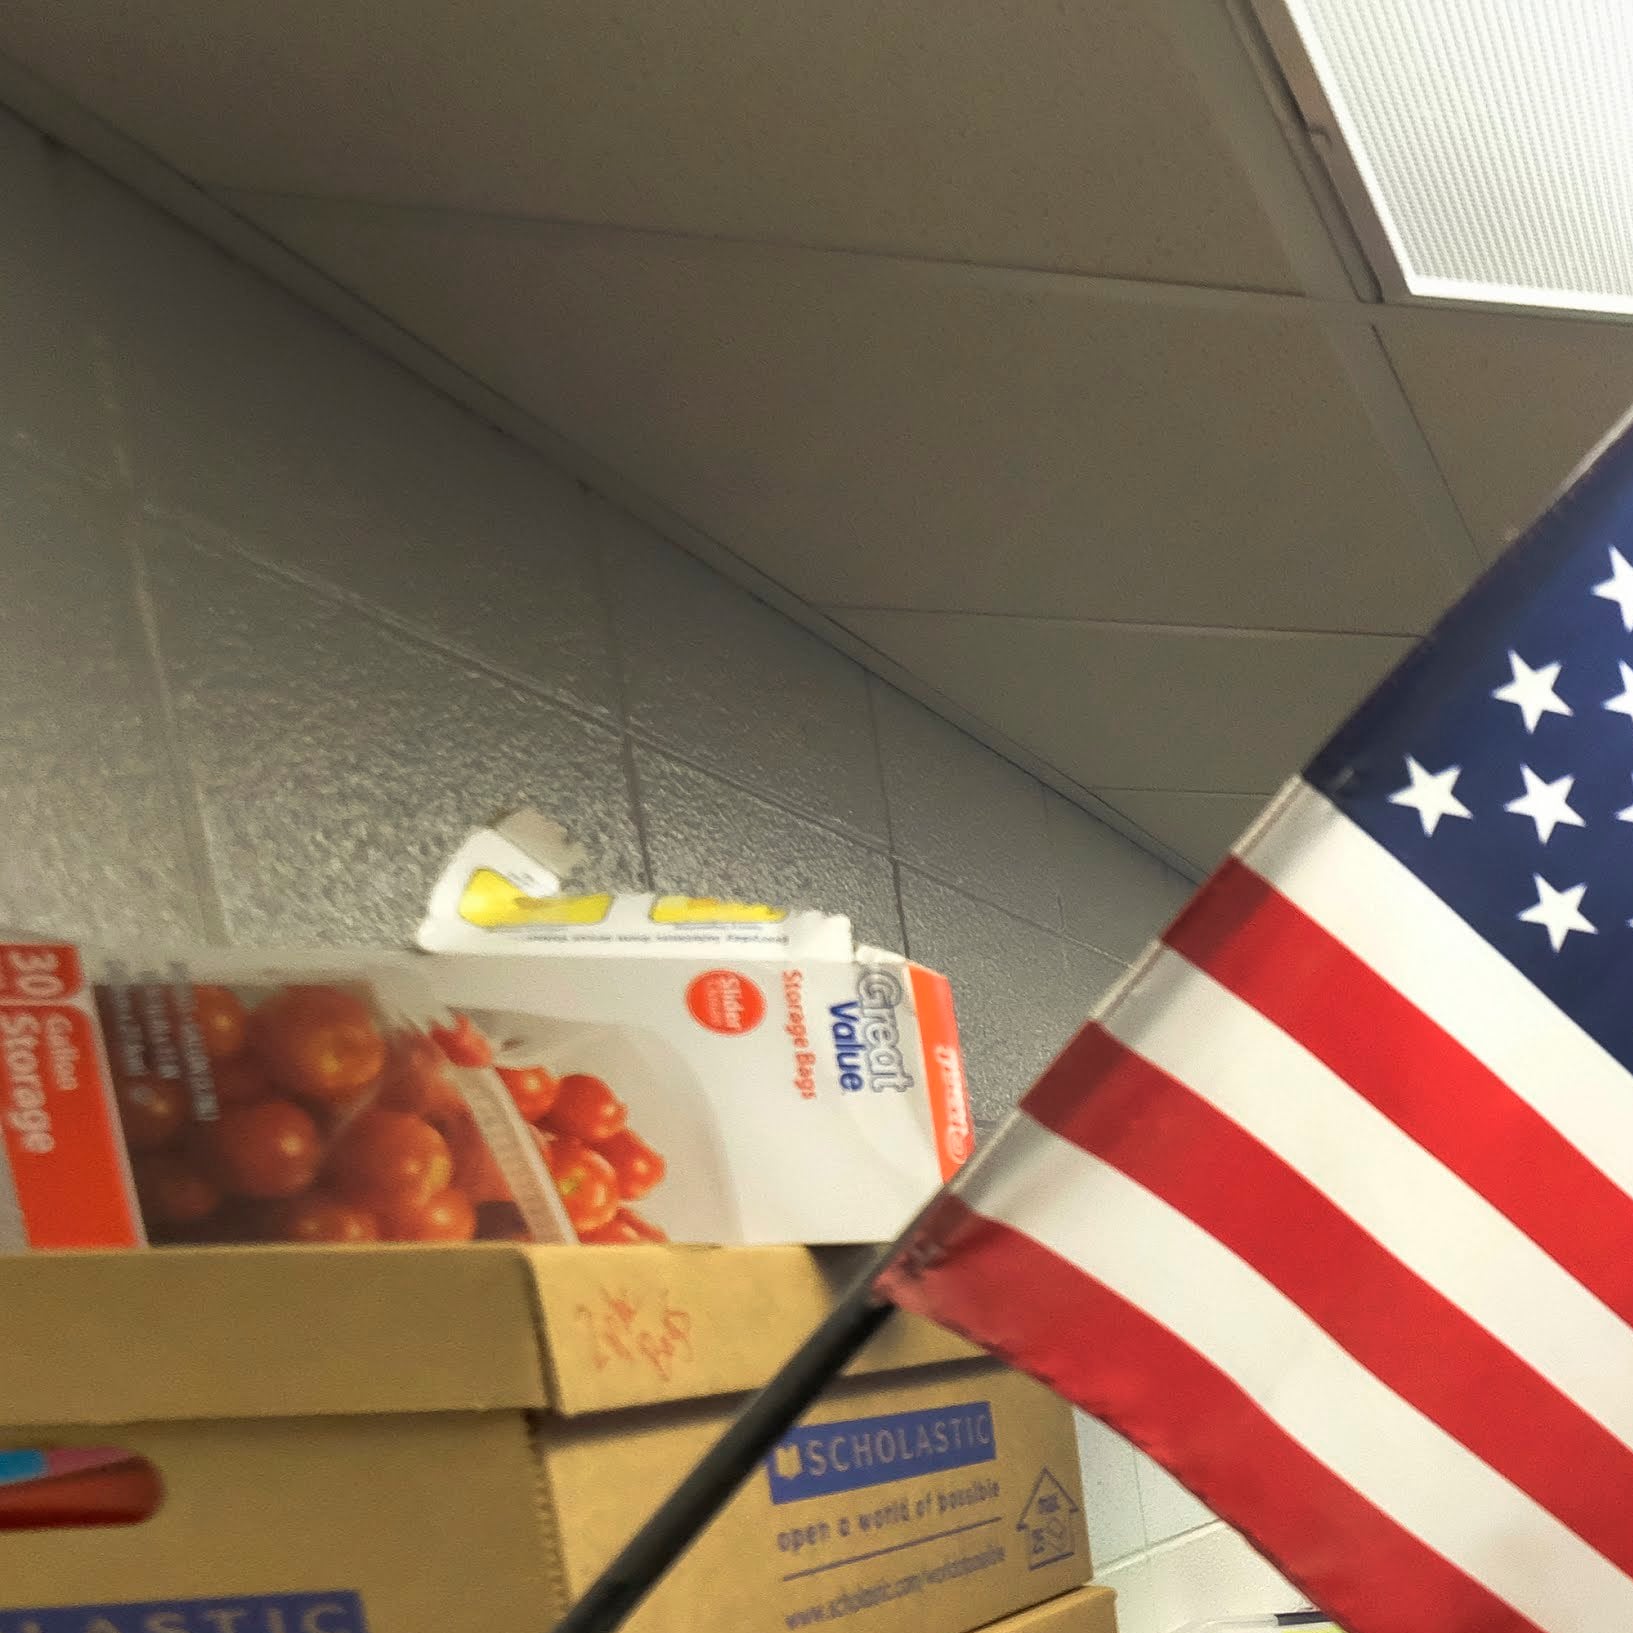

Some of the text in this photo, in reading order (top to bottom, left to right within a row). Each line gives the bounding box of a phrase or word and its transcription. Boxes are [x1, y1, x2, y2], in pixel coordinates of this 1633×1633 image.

[1, 1010, 56, 1154] Storage
[782, 968, 817, 1101] Storage Bags
[827, 1000, 866, 1092] Value
[856, 967, 915, 1094] Great
[805, 1412, 994, 1477] SCHOLASTIC
[776, 1478, 1001, 1553] open a world of possible
